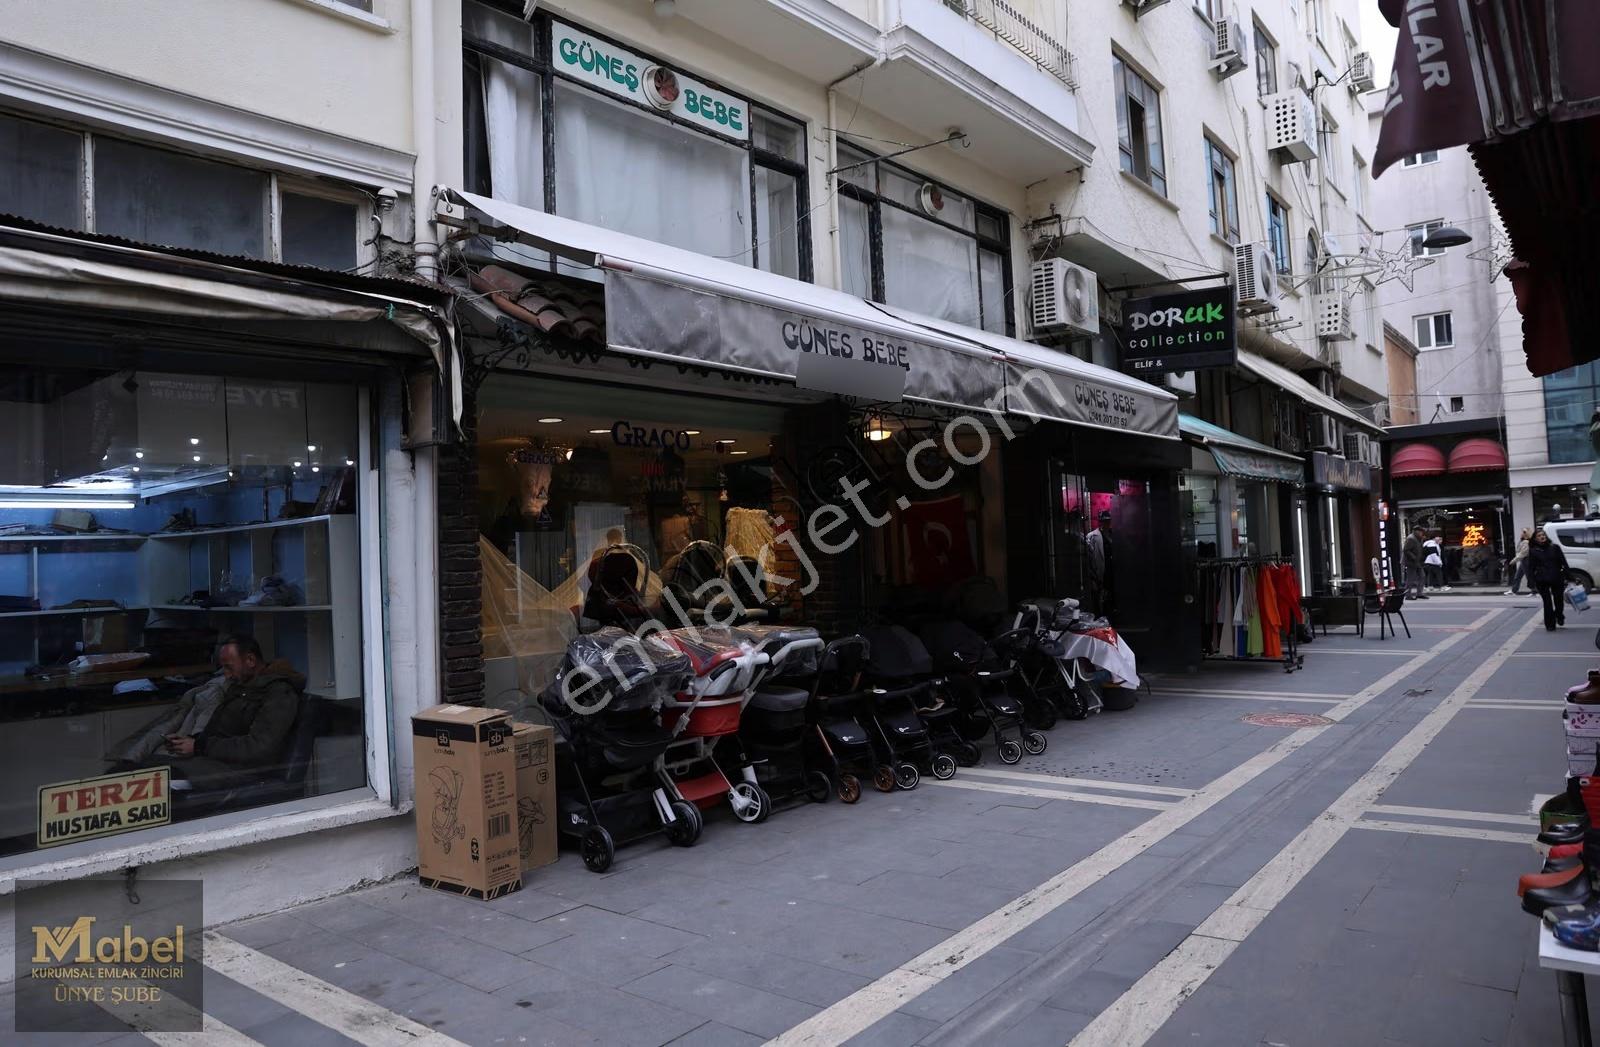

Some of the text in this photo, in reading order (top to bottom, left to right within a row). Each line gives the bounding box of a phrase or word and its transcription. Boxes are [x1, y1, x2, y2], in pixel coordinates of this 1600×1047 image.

[1406, 0, 1451, 91] LAR
[559, 38, 744, 131] GÜNEŞ BEBE
[862, 337, 910, 371] BEBE
[1129, 330, 1224, 349] collection
[1074, 382, 1136, 416] GÜNEŞ BEBE
[612, 420, 690, 449] GRACO
[52, 772, 162, 814] TERZİ
[46, 802, 167, 838] MUSTAFA SARI
